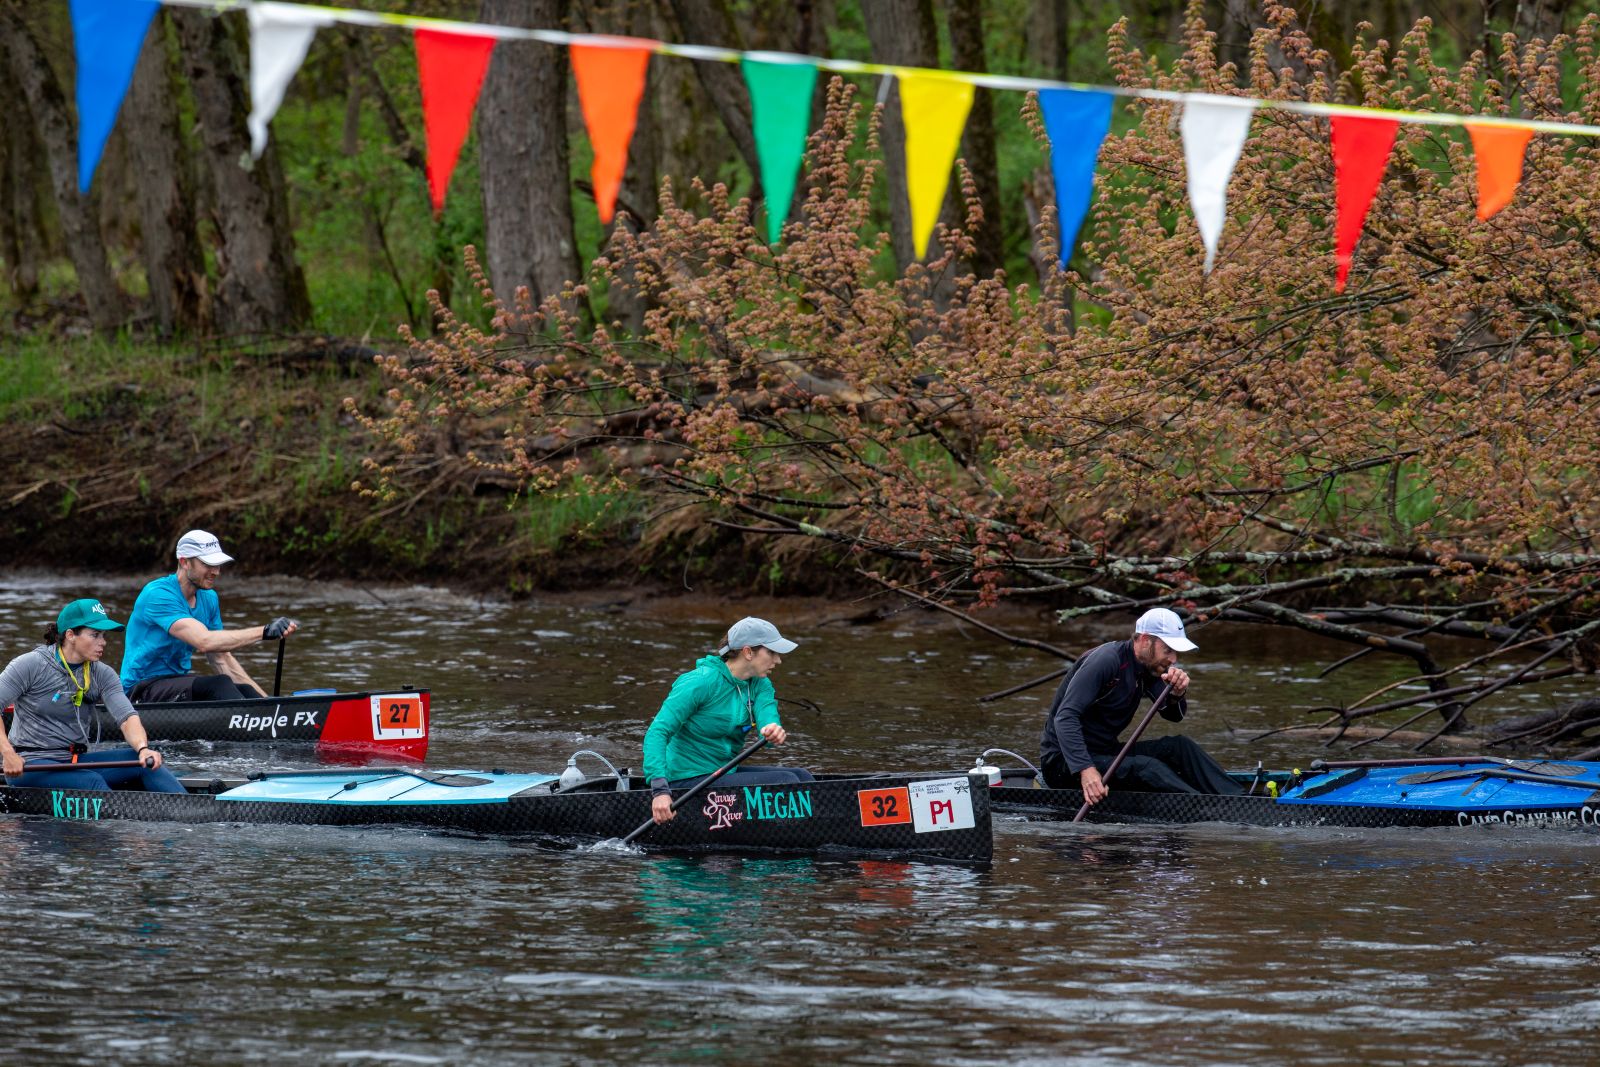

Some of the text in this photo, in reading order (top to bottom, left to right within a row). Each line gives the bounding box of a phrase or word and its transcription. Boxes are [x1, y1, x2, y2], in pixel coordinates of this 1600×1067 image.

[228, 704, 289, 738] Ripple
[389, 703, 410, 723] 27
[703, 791, 737, 815] Savage
[743, 786, 813, 820] MEGAN
[871, 795, 898, 818] 32
[929, 799, 954, 825] P1
[708, 805, 743, 830] River
